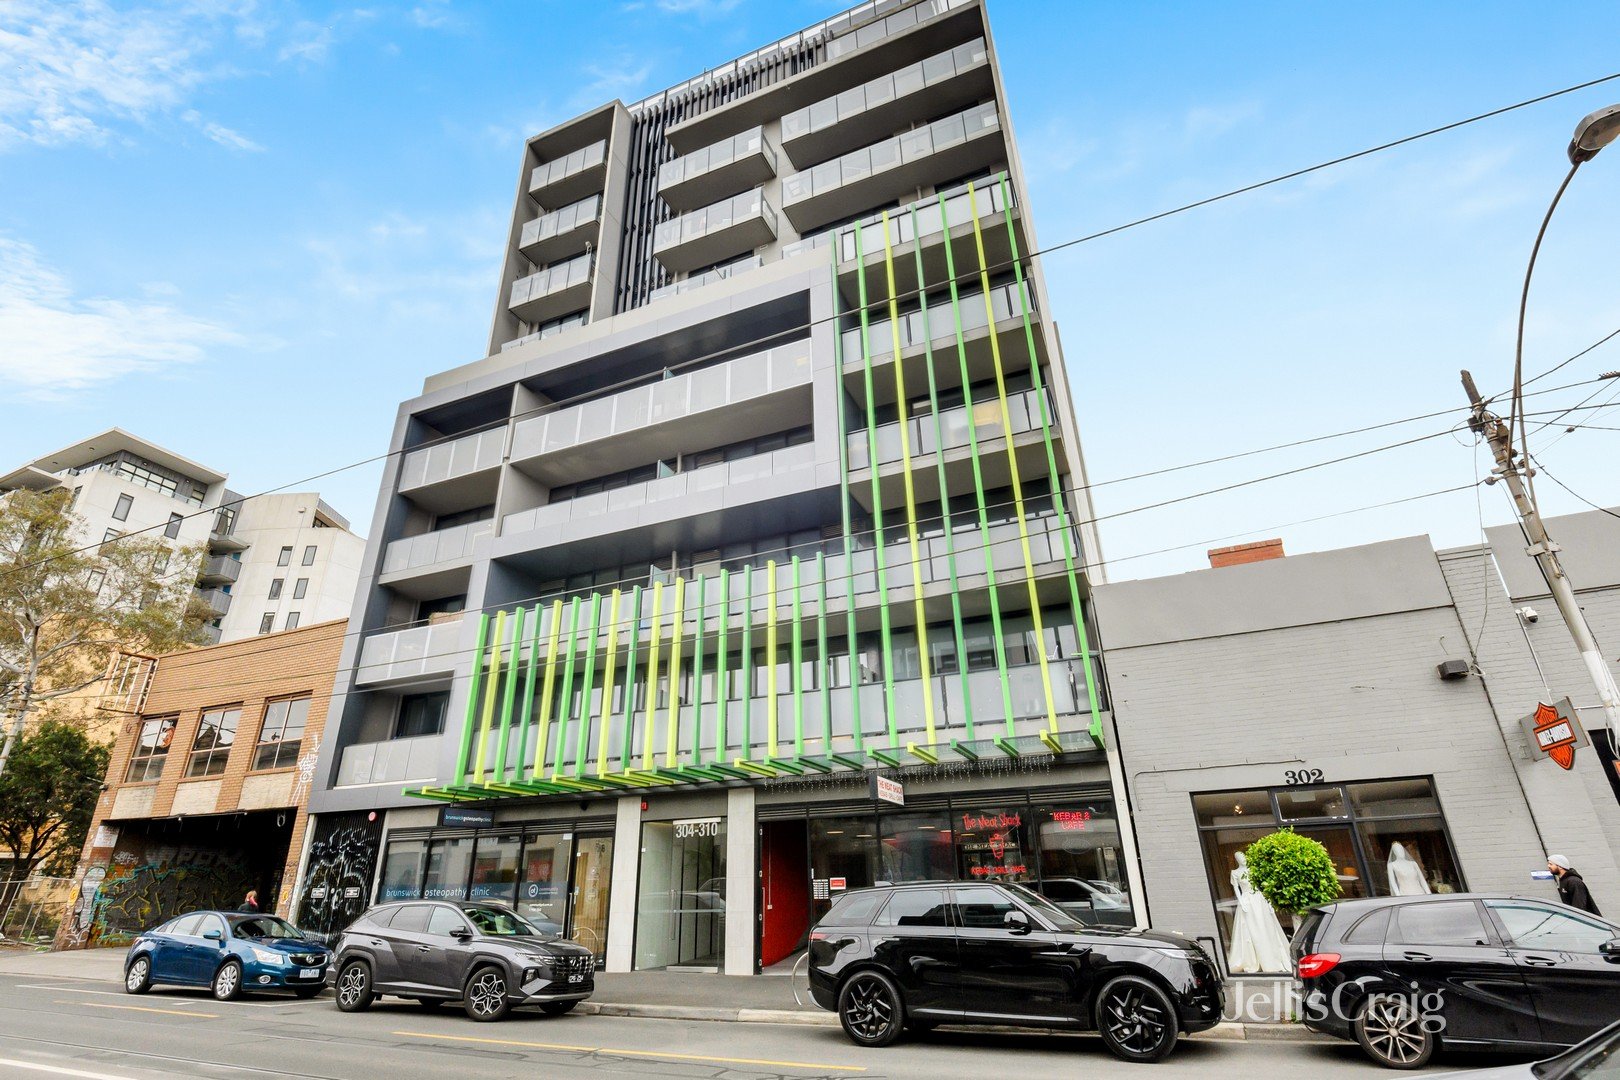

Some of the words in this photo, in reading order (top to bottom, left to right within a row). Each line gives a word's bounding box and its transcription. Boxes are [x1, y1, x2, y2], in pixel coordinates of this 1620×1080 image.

[1284, 768, 1325, 786] 302
[962, 813, 976, 830] The
[977, 815, 998, 829] Meat
[999, 811, 1021, 828] Shack
[675, 822, 718, 838] 304-310
[385, 887, 421, 897] brunswick
[424, 887, 467, 899] osteopathy
[470, 887, 490, 896] clinic
